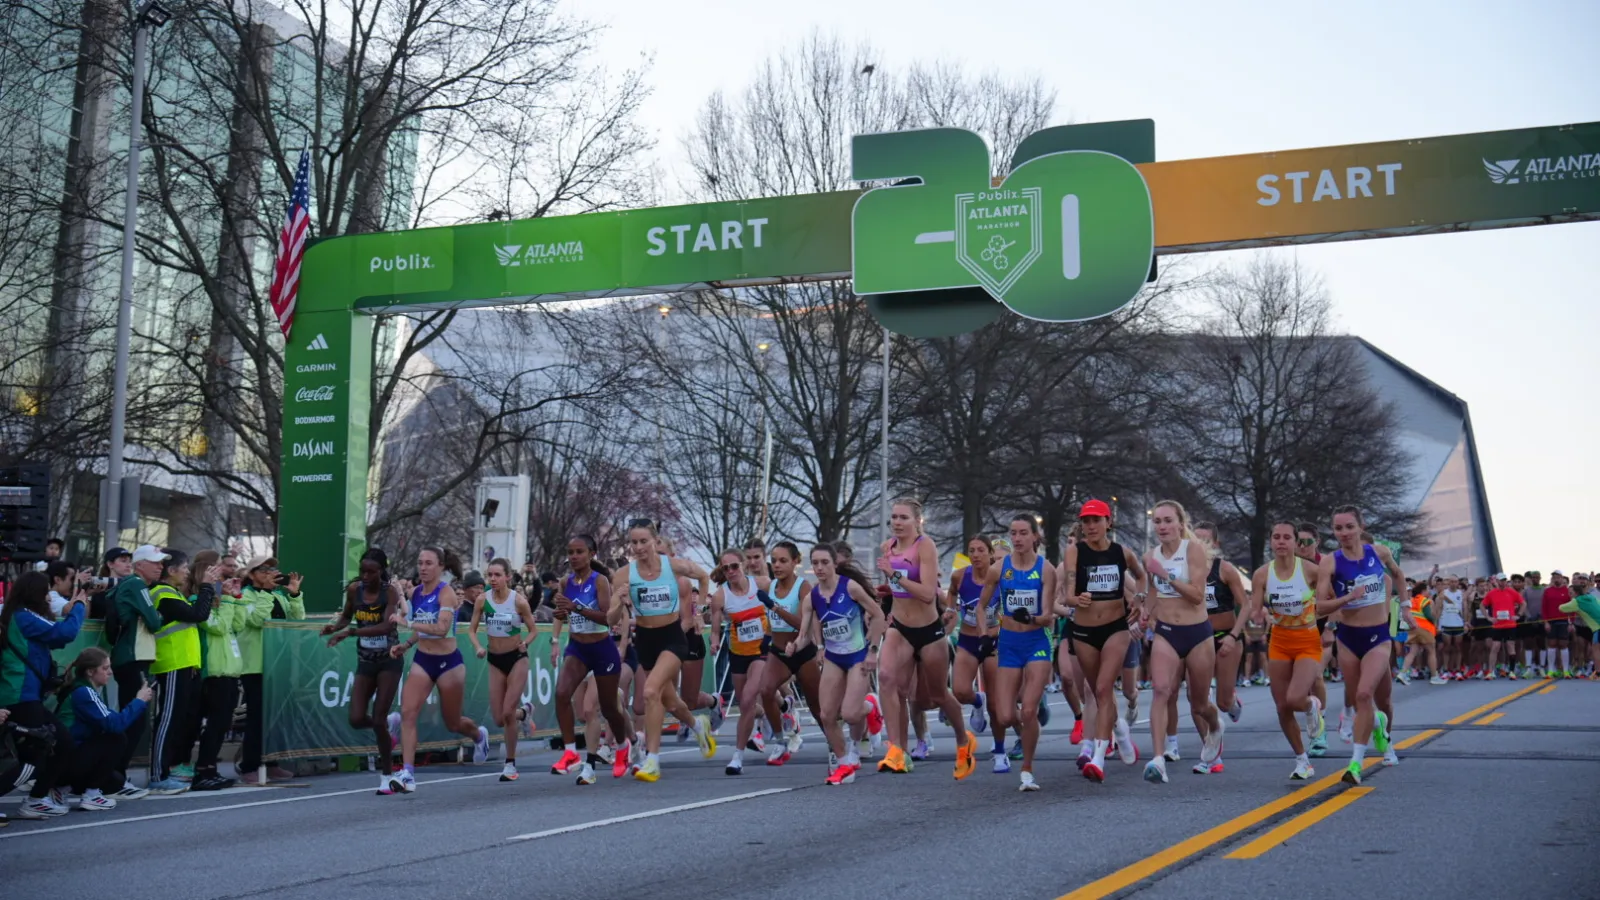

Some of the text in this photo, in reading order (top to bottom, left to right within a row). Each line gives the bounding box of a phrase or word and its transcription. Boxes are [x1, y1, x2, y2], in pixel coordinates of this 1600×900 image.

[1524, 153, 1600, 174] ATLANTA
[1525, 169, 1600, 182] TRACK CLU
[1256, 163, 1403, 206] START
[978, 190, 1018, 201] Publix
[968, 204, 1028, 219] ATLANTA
[977, 221, 1020, 230] MARATHON
[646, 217, 769, 256] START
[524, 240, 584, 258] ATLANTA
[370, 253, 431, 273] Publix
[296, 363, 336, 373] GARMIN
[295, 384, 336, 402] Coca-Cola
[294, 415, 336, 425] BODYARMOR
[293, 438, 334, 460] DASANI
[292, 473, 333, 483] POWERADE
[1088, 573, 1120, 583] MONTOYA
[640, 593, 670, 603] MCCLAIN
[1008, 596, 1035, 606] SAILOR
[739, 624, 760, 636] SMITH
[824, 625, 849, 638] HURLEY
